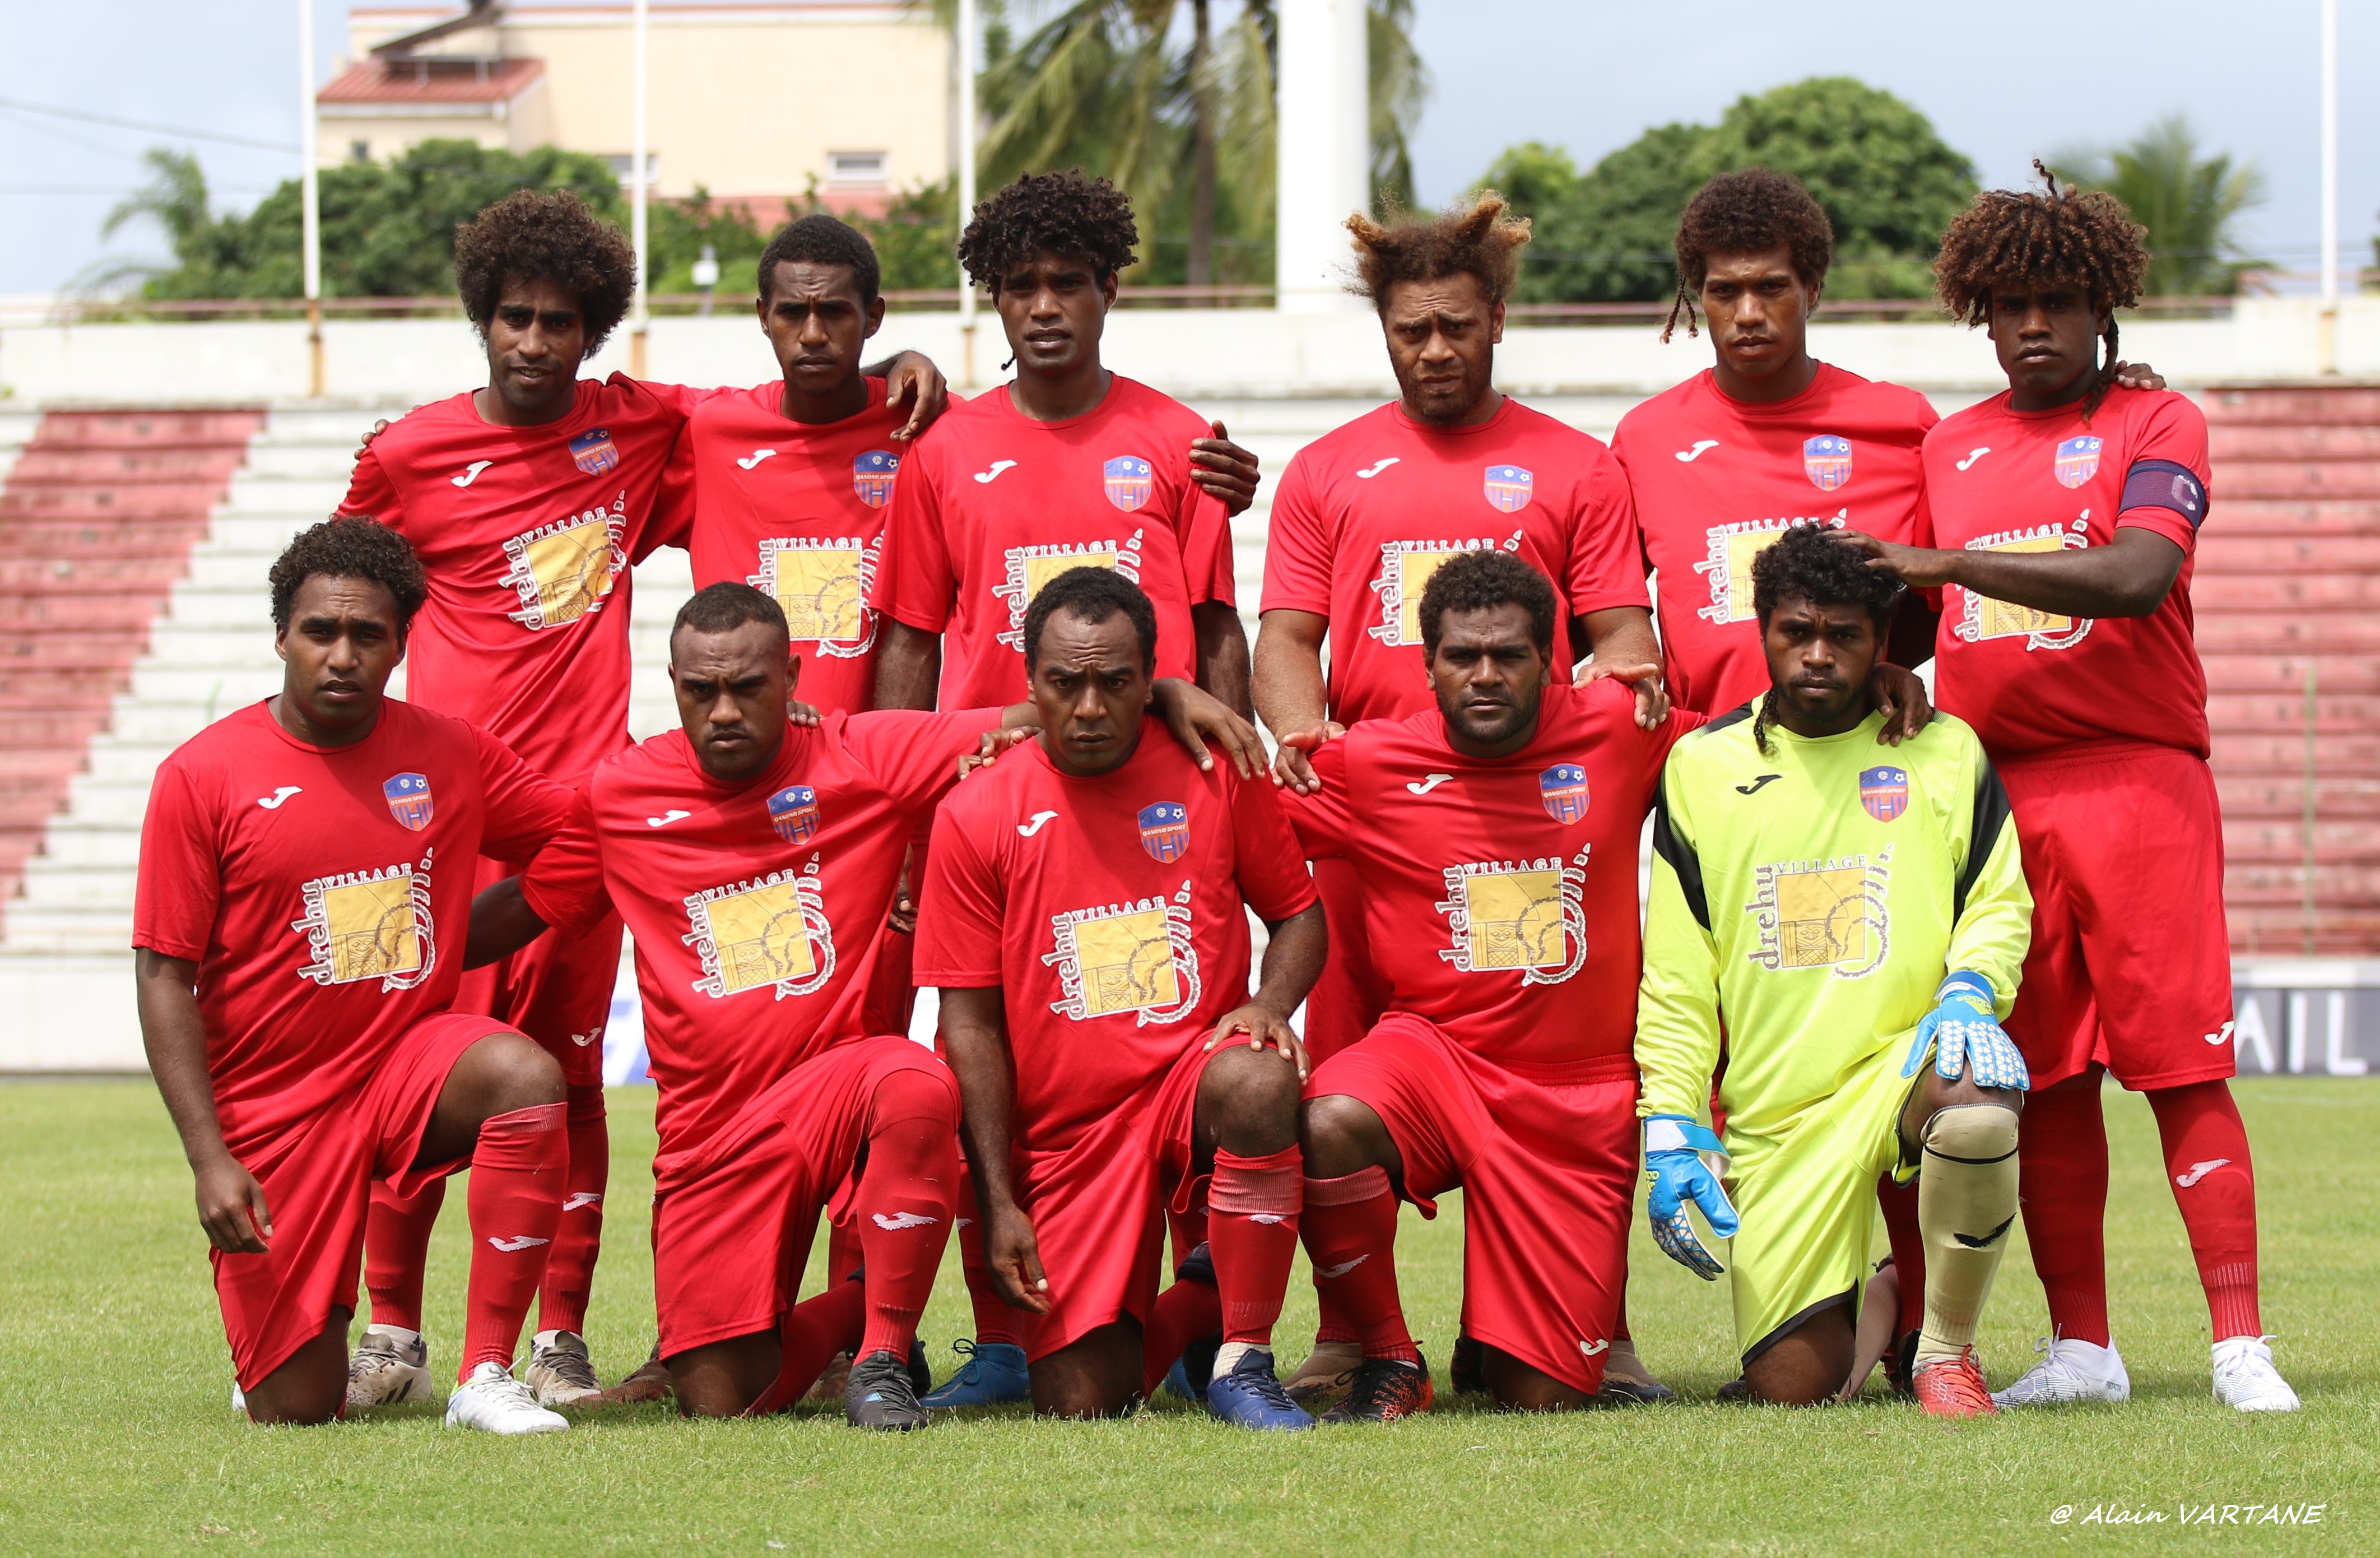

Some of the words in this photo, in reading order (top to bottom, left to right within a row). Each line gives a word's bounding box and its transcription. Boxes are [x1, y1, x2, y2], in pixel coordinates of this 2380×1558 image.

[575, 449, 595, 460] QANONO
[595, 442, 611, 452] SPORT
[524, 507, 607, 544] VILLAGE
[1982, 523, 2063, 547] VILLAGE
[777, 537, 862, 550] VILLAGE
[1025, 540, 1117, 557] VILLAGE
[1402, 539, 1495, 551] VILLAGE
[499, 536, 544, 630] drehu
[1693, 525, 1731, 624] drehu
[1369, 540, 1400, 647] drehu
[390, 797, 412, 805] QANONO
[1544, 789, 1568, 798] QANONO
[774, 812, 798, 822] QANONO
[797, 806, 816, 815] SPORT
[1142, 827, 1166, 837] QANONO
[1166, 824, 1186, 832] SPORT
[323, 863, 412, 889] VILLAGE
[1465, 857, 1562, 875] VILLAGE
[1776, 855, 1866, 874] VILLAGE
[703, 869, 795, 901] VILLAGE
[1073, 896, 1166, 922] VILLAGE
[1435, 864, 1472, 972] drehu
[1745, 864, 1779, 970] drehu
[291, 878, 334, 986] drehu
[681, 892, 725, 998] drehu
[1041, 911, 1086, 1021] drehu
